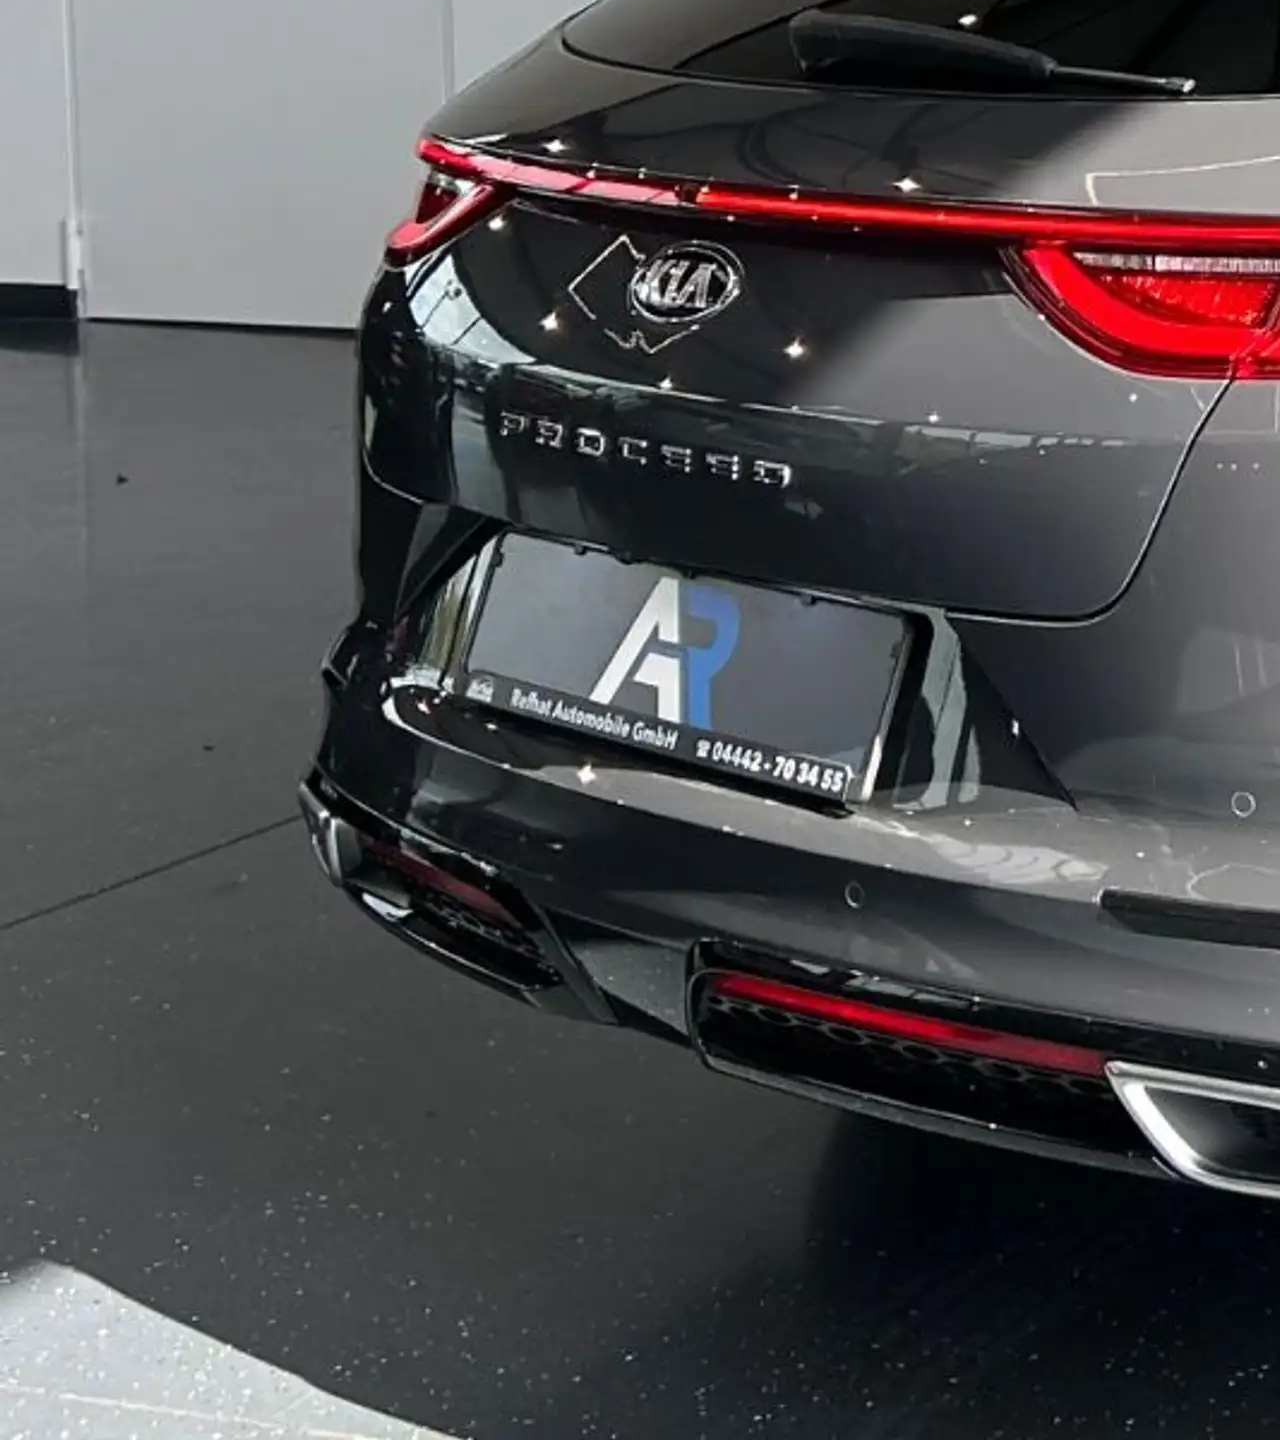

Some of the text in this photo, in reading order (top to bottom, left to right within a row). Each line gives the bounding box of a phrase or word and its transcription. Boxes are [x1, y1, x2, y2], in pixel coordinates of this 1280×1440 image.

[552, 699, 630, 738] Automobile
[632, 720, 678, 750] GmbH
[711, 740, 762, 772] 04442
